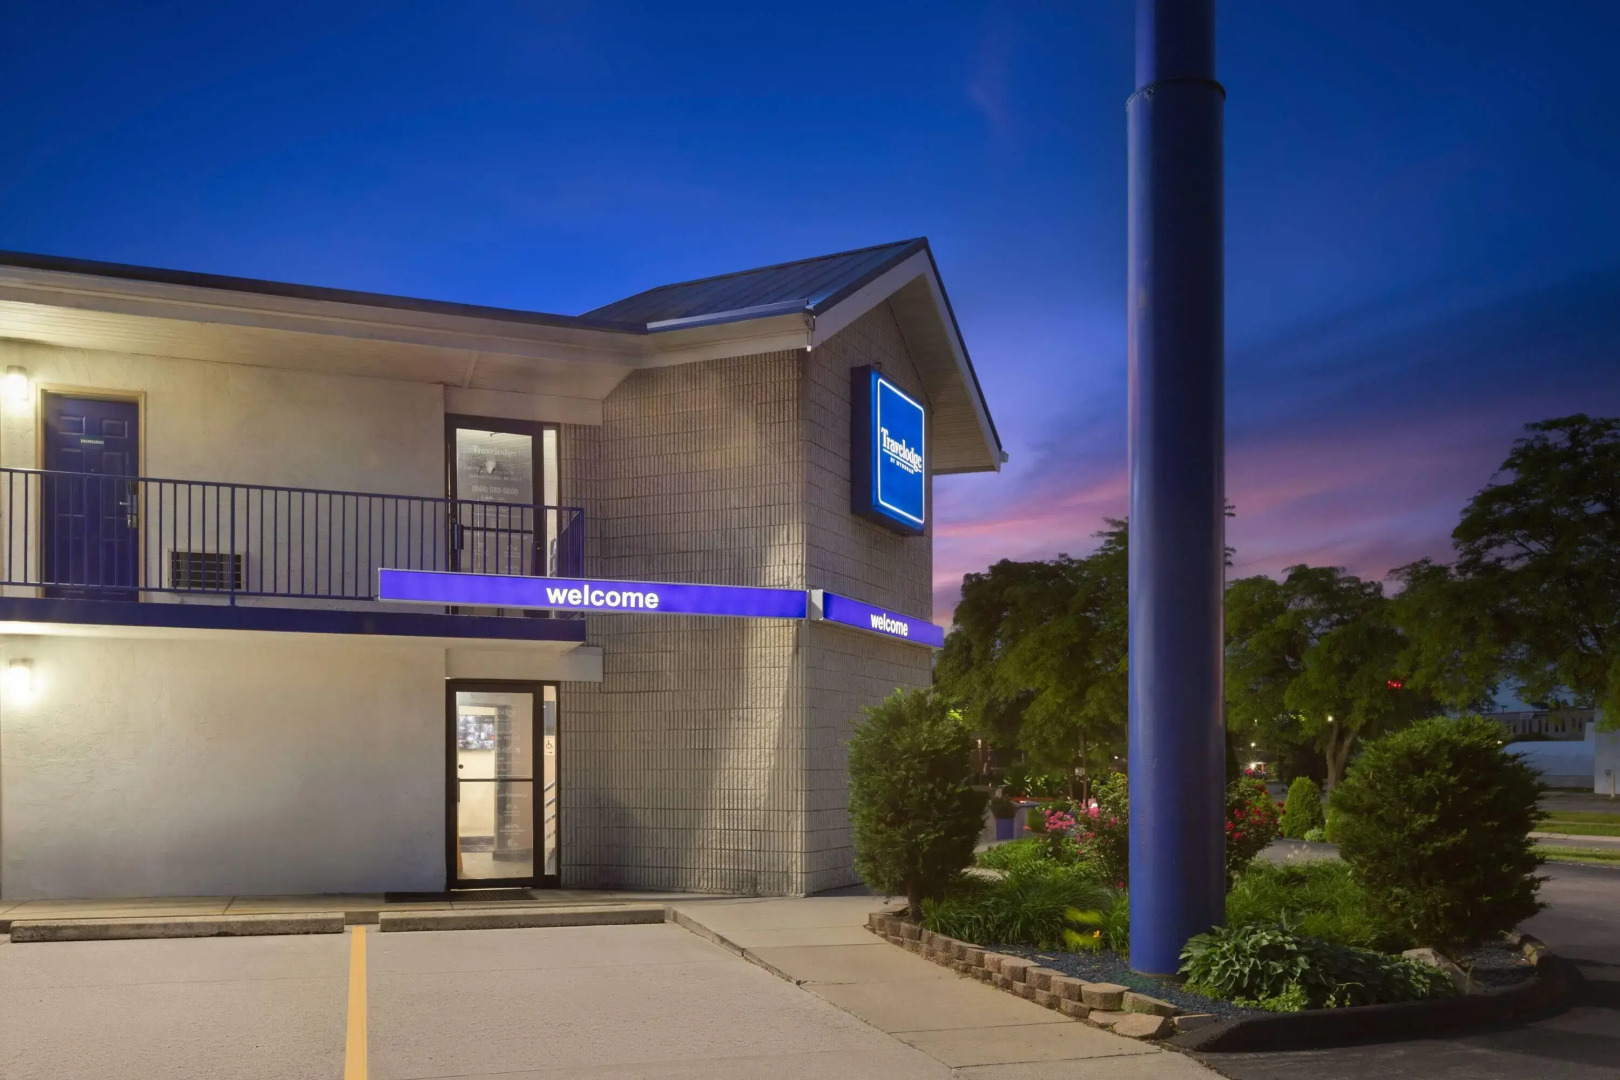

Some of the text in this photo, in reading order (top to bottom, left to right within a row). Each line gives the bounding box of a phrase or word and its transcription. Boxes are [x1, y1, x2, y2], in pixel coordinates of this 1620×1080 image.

[880, 426, 922, 473] Travelodge
[546, 584, 659, 609] welcome
[870, 612, 909, 637] welcome
